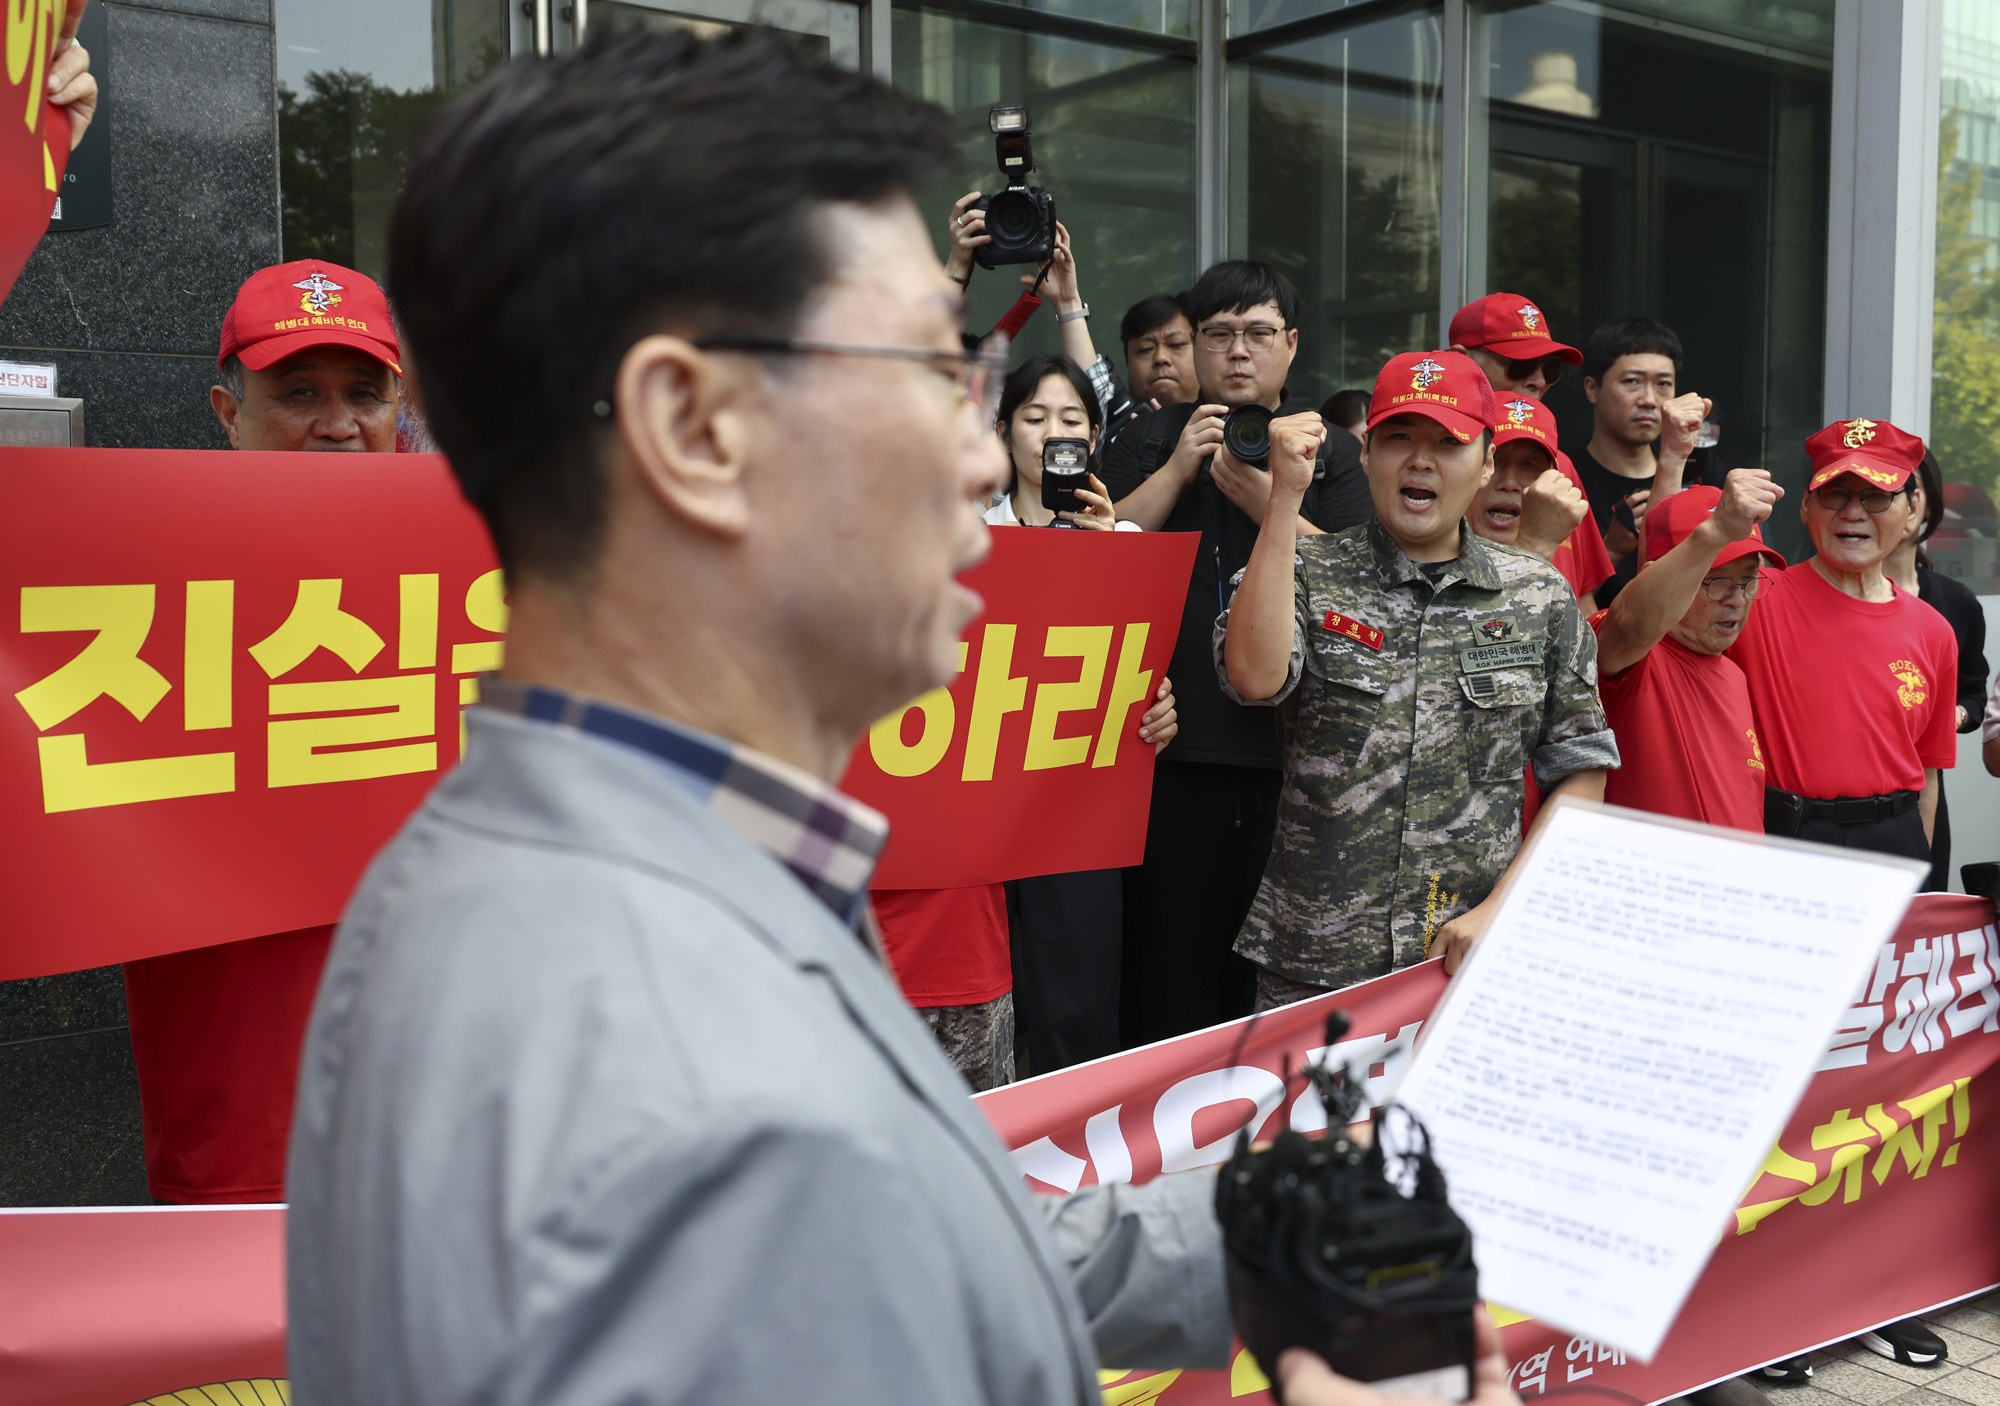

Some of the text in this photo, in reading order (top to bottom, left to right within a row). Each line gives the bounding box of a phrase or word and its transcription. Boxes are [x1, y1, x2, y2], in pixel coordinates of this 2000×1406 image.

[274, 316, 368, 332] 해병대 예비역 연대
[1495, 423, 1513, 432] 병대
[1468, 643, 1536, 661] 대한민국 해병대
[1493, 658, 1515, 666] MARINE
